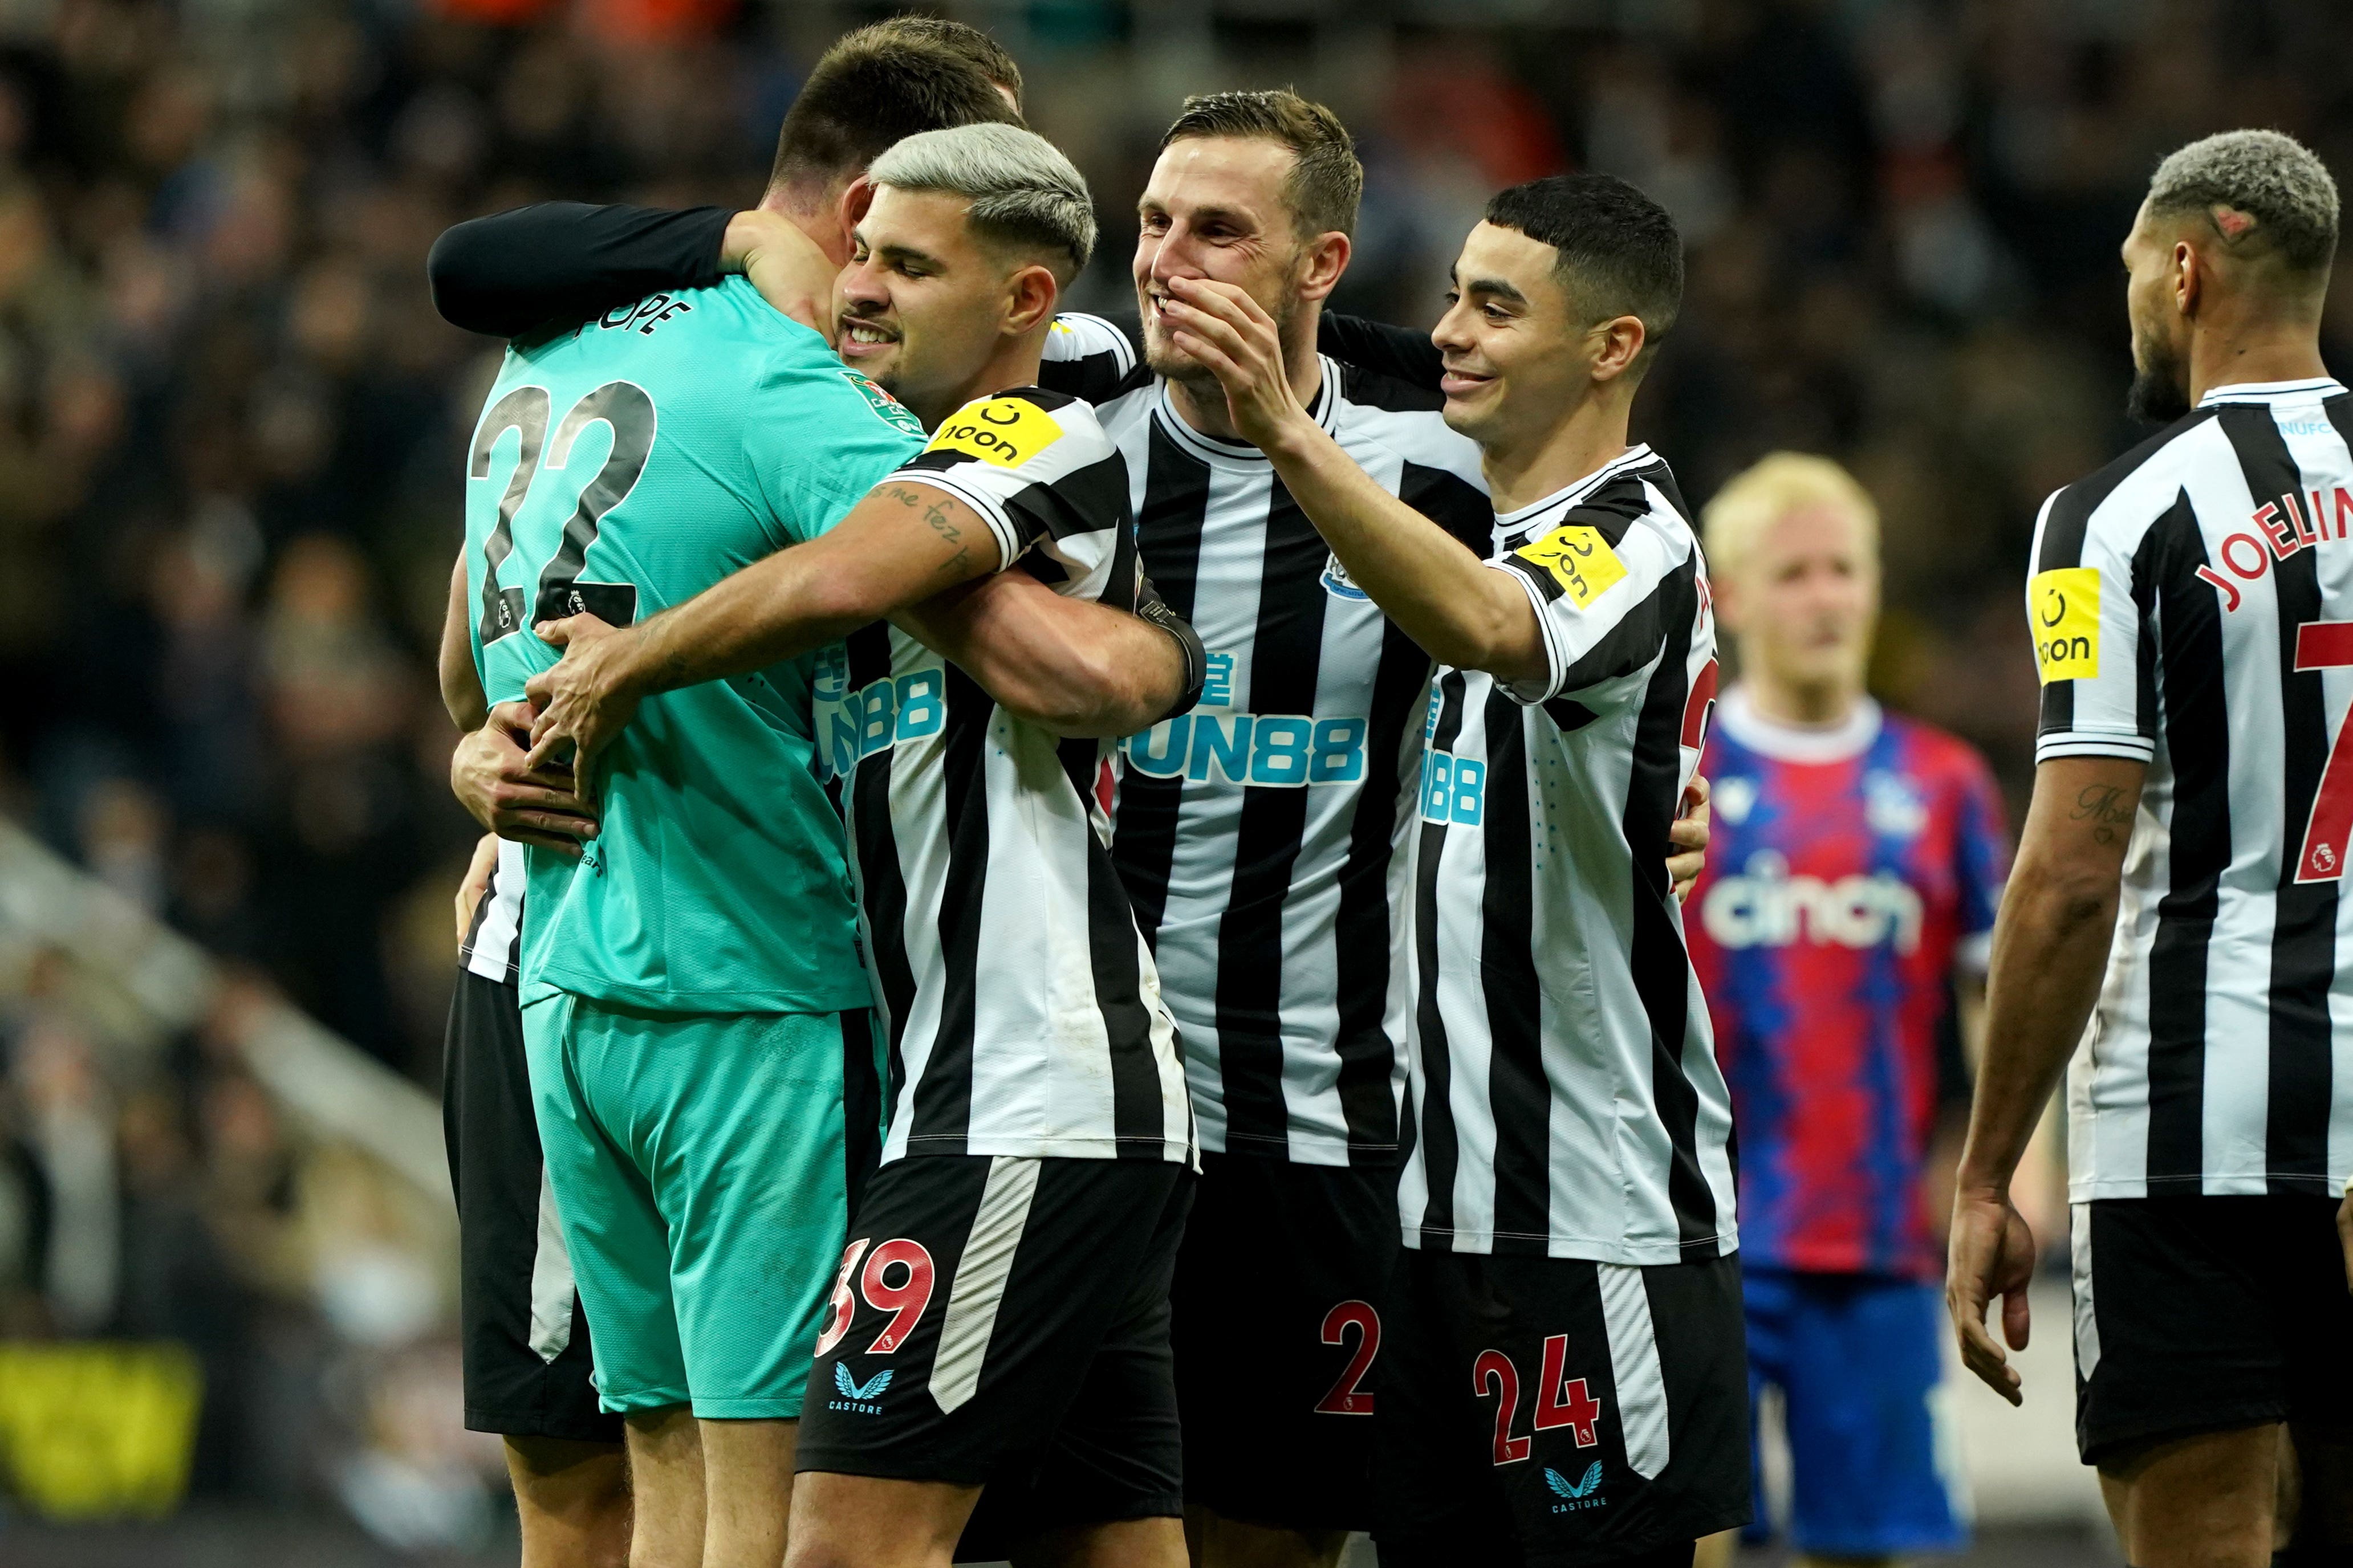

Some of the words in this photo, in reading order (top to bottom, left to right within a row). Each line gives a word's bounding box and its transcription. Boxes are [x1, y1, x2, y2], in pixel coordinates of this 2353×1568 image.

[934, 425, 1018, 462] noon
[2280, 422, 2332, 435] NUFC
[470, 379, 658, 649] 22
[1117, 714, 1368, 784] UN88
[2293, 622, 2353, 885] 7
[814, 1237, 935, 1358] 39
[828, 1400, 883, 1415] CASTORE
[1473, 1334, 1600, 1467] 24
[1551, 1496, 1608, 1514] CASTORE
